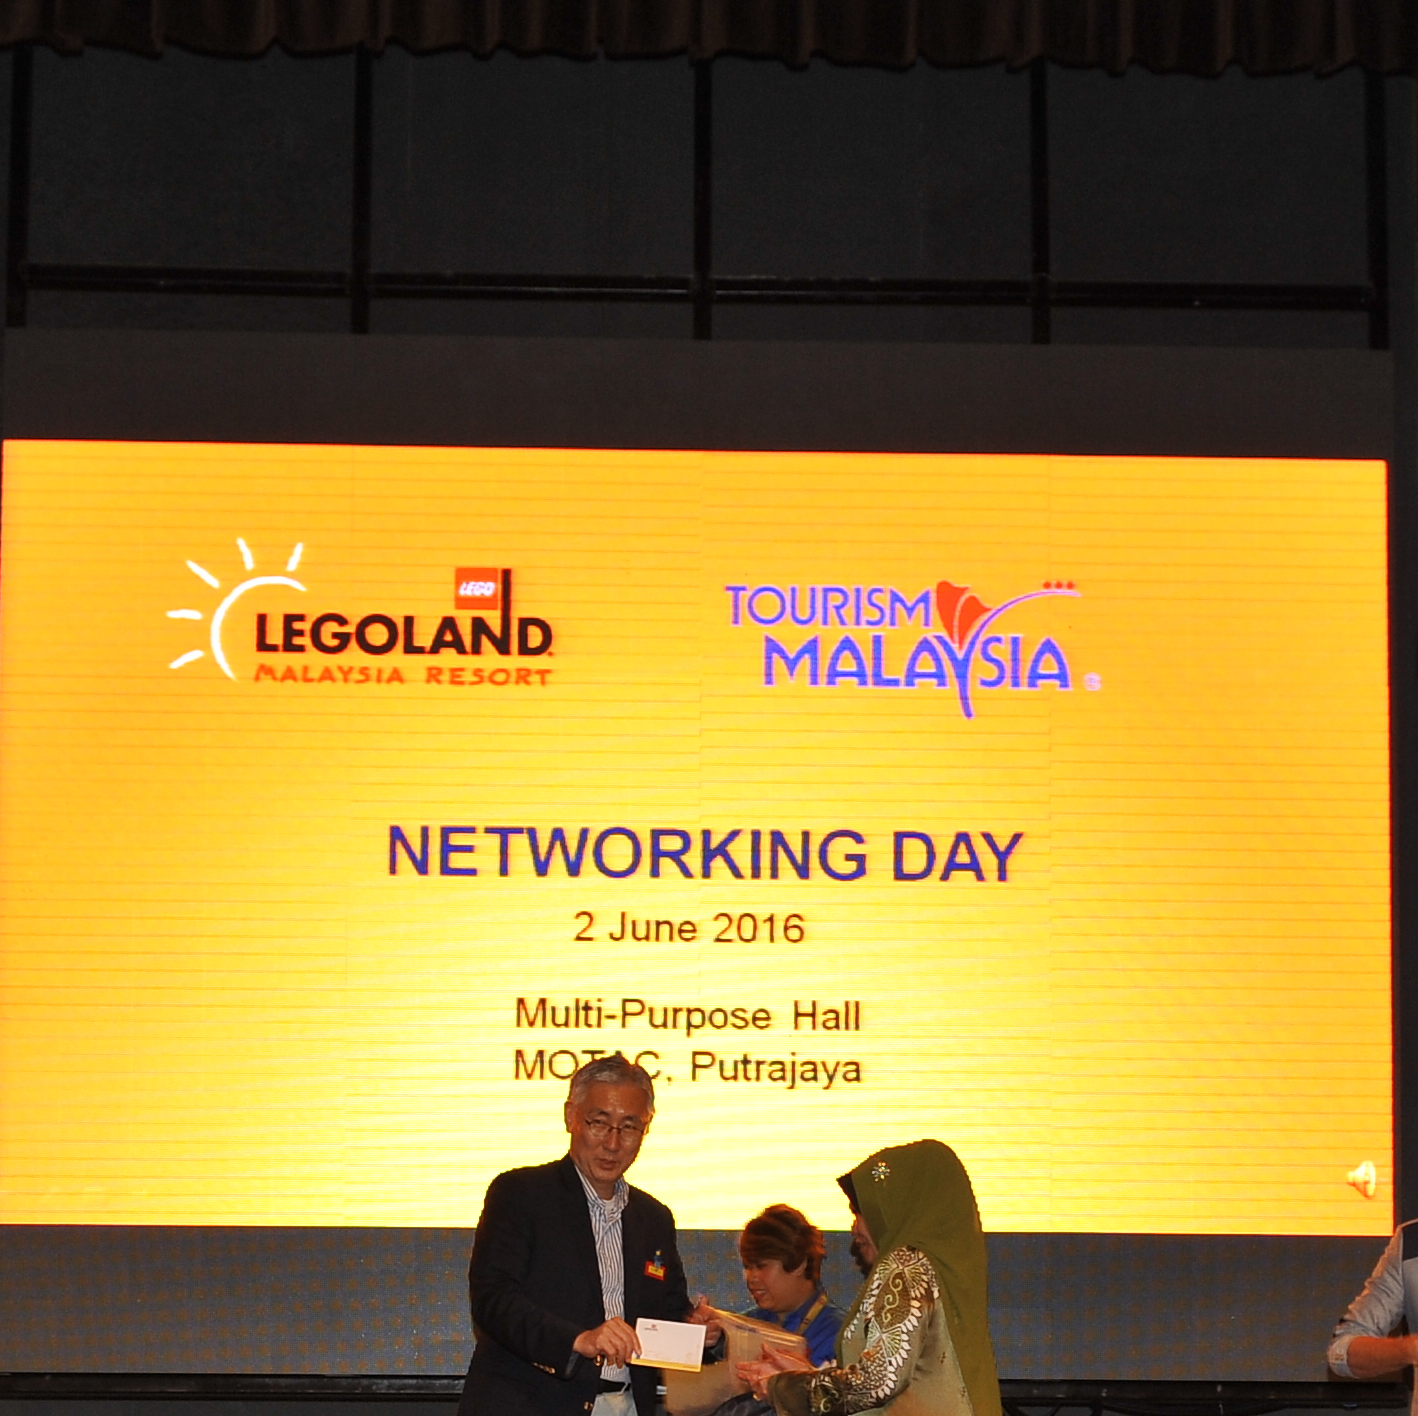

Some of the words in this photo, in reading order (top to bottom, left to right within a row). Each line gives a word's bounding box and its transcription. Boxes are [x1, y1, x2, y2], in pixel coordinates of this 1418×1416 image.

[458, 581, 495, 596] LEGO
[724, 585, 932, 627] TOURISM
[255, 568, 554, 657] LEGOLAND
[254, 662, 405, 684] MALAYSIA
[425, 666, 554, 686] RESORT
[763, 633, 1072, 718] MALAYSIA
[387, 825, 868, 882] NETWORKING
[892, 831, 1024, 882] DAY
[573, 911, 595, 942] 2
[609, 911, 698, 943] June
[713, 912, 805, 944] 2016
[515, 997, 772, 1037] Multi-Purpose
[793, 1000, 862, 1031] Hall
[691, 1050, 862, 1089] Putrajaya
